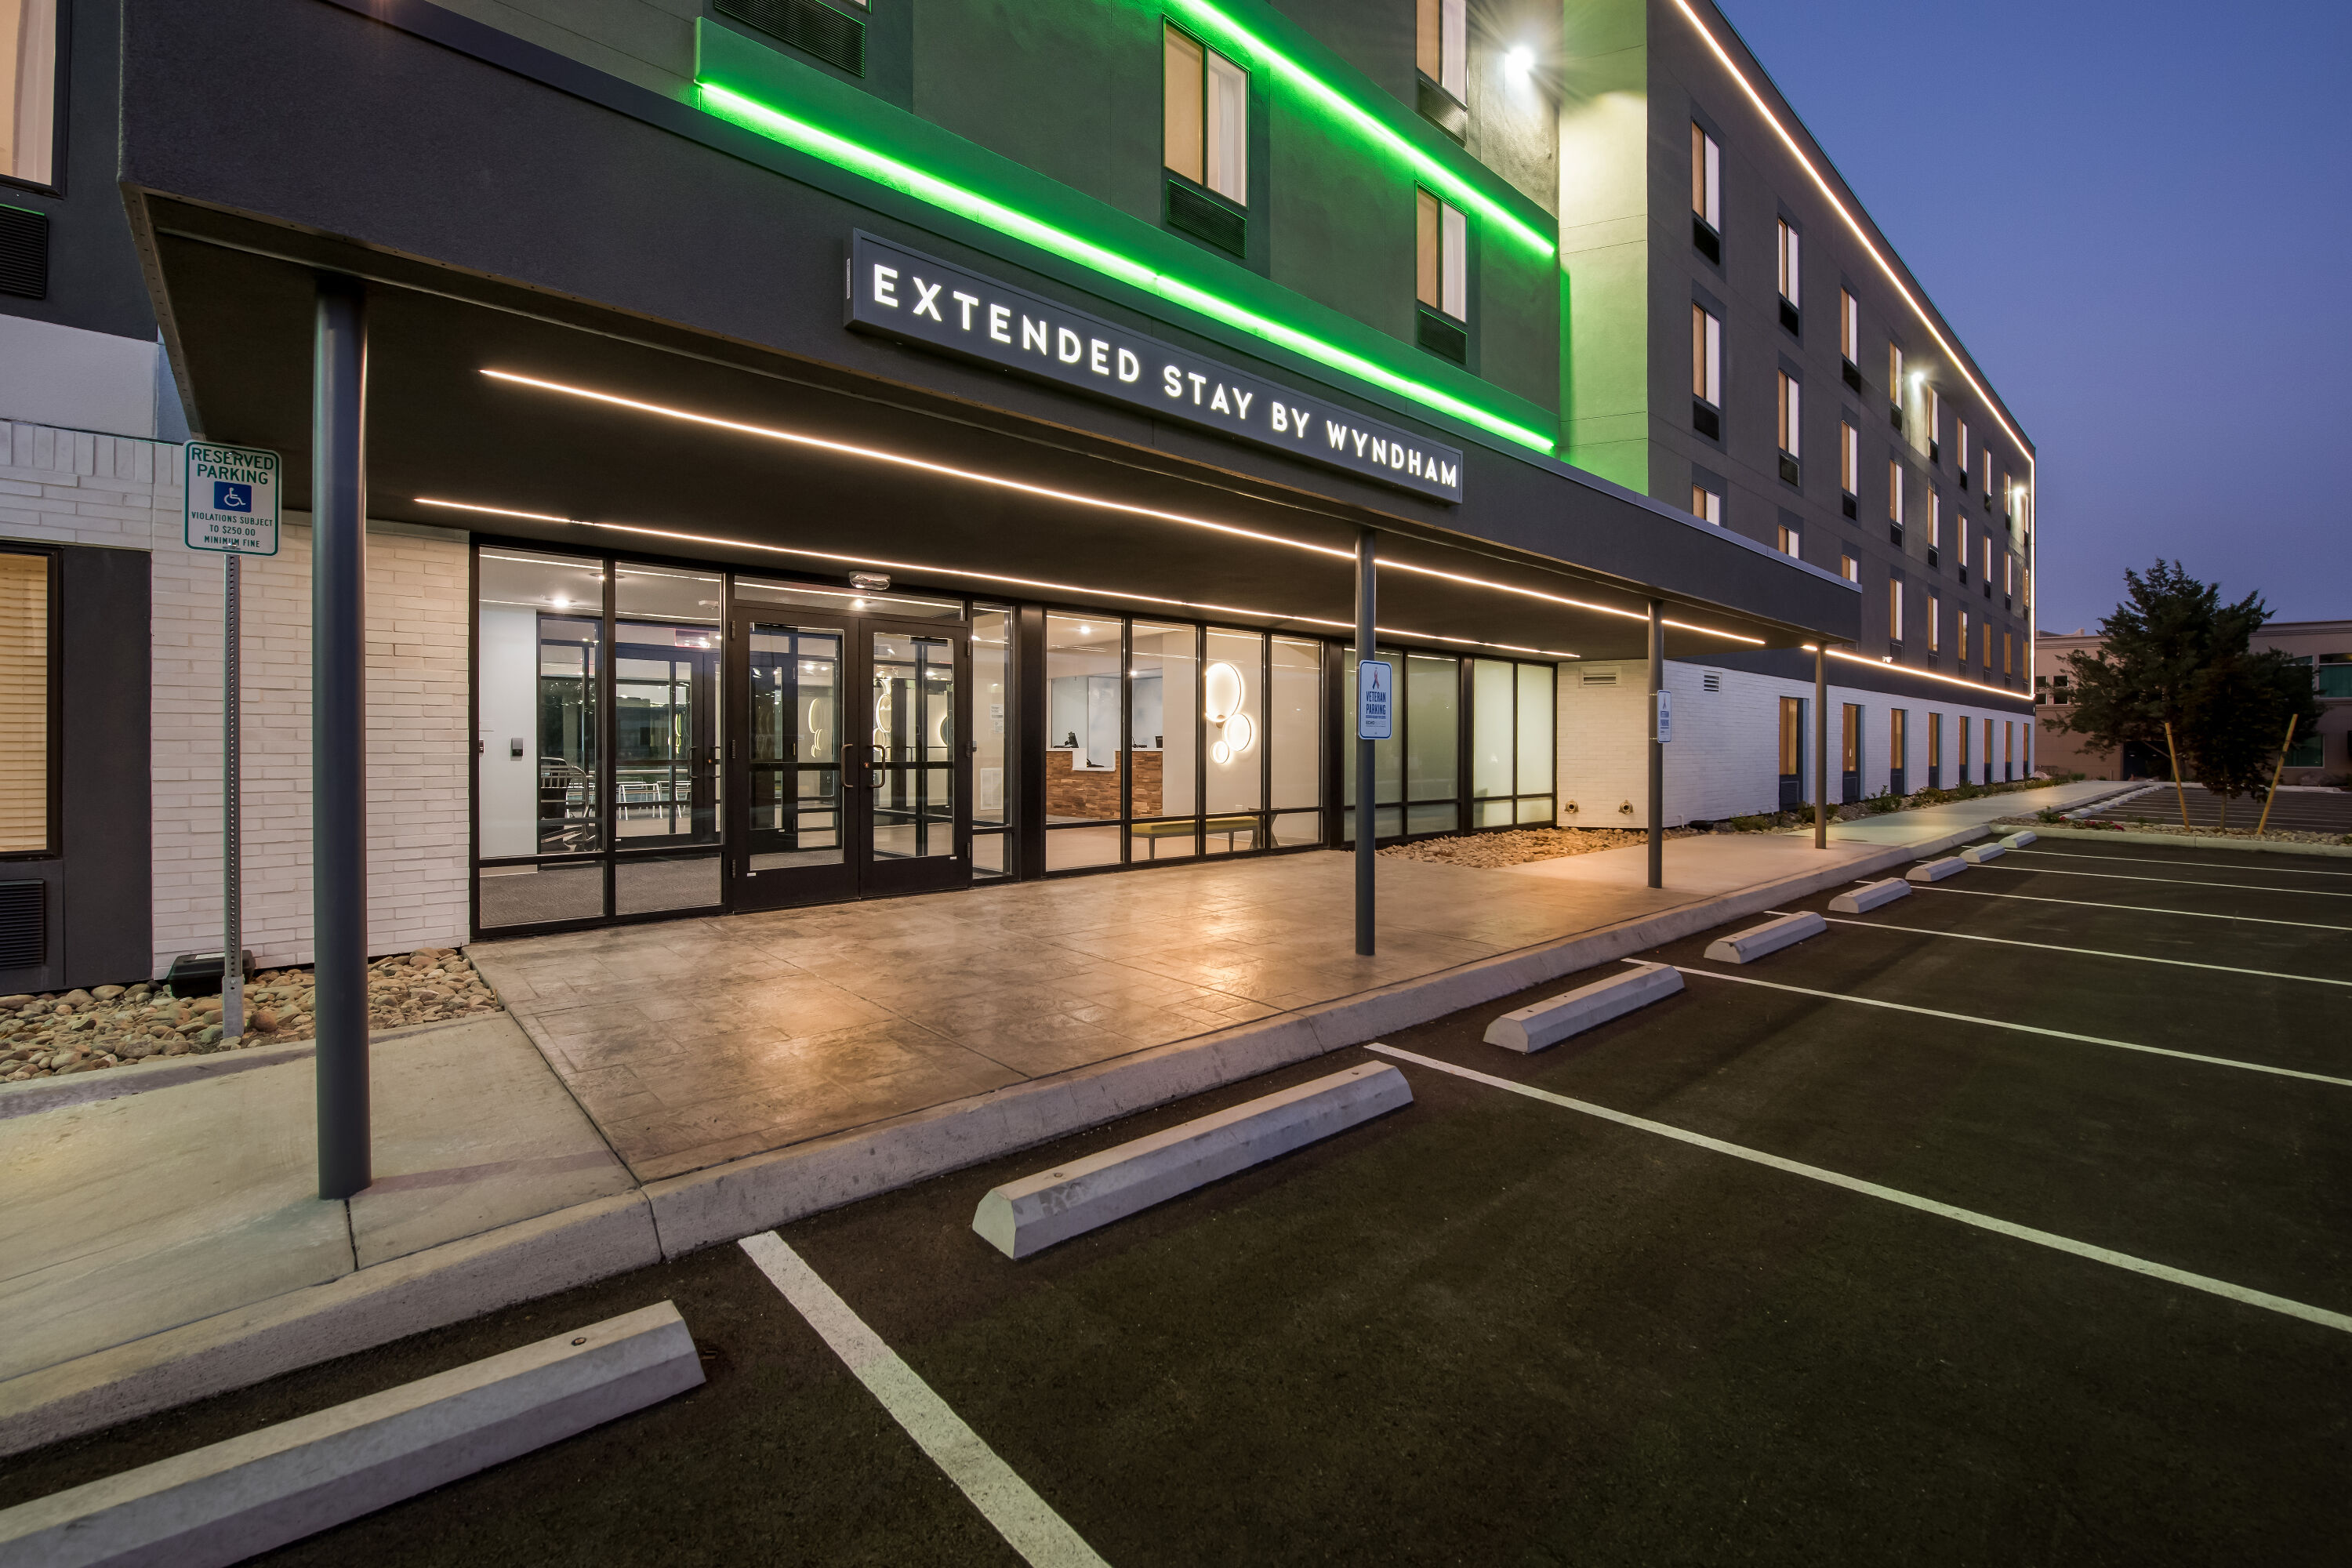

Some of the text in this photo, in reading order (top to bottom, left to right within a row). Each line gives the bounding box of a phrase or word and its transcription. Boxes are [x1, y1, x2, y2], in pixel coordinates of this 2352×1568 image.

[873, 263, 1141, 383] EXTENDED
[1163, 364, 1253, 420] STAY
[1272, 401, 1310, 438] BY
[1326, 419, 1457, 488] WYNDHAM
[191, 447, 274, 470] RESERVED
[197, 463, 268, 485] PARKING
[191, 511, 273, 527] VIOLATIONS SUBJECT
[209, 524, 256, 536] TO $250.00
[204, 535, 260, 548] MINIMUM FINE
[1366, 691, 1386, 702] VETERAN
[1366, 704, 1386, 715] PARKING
